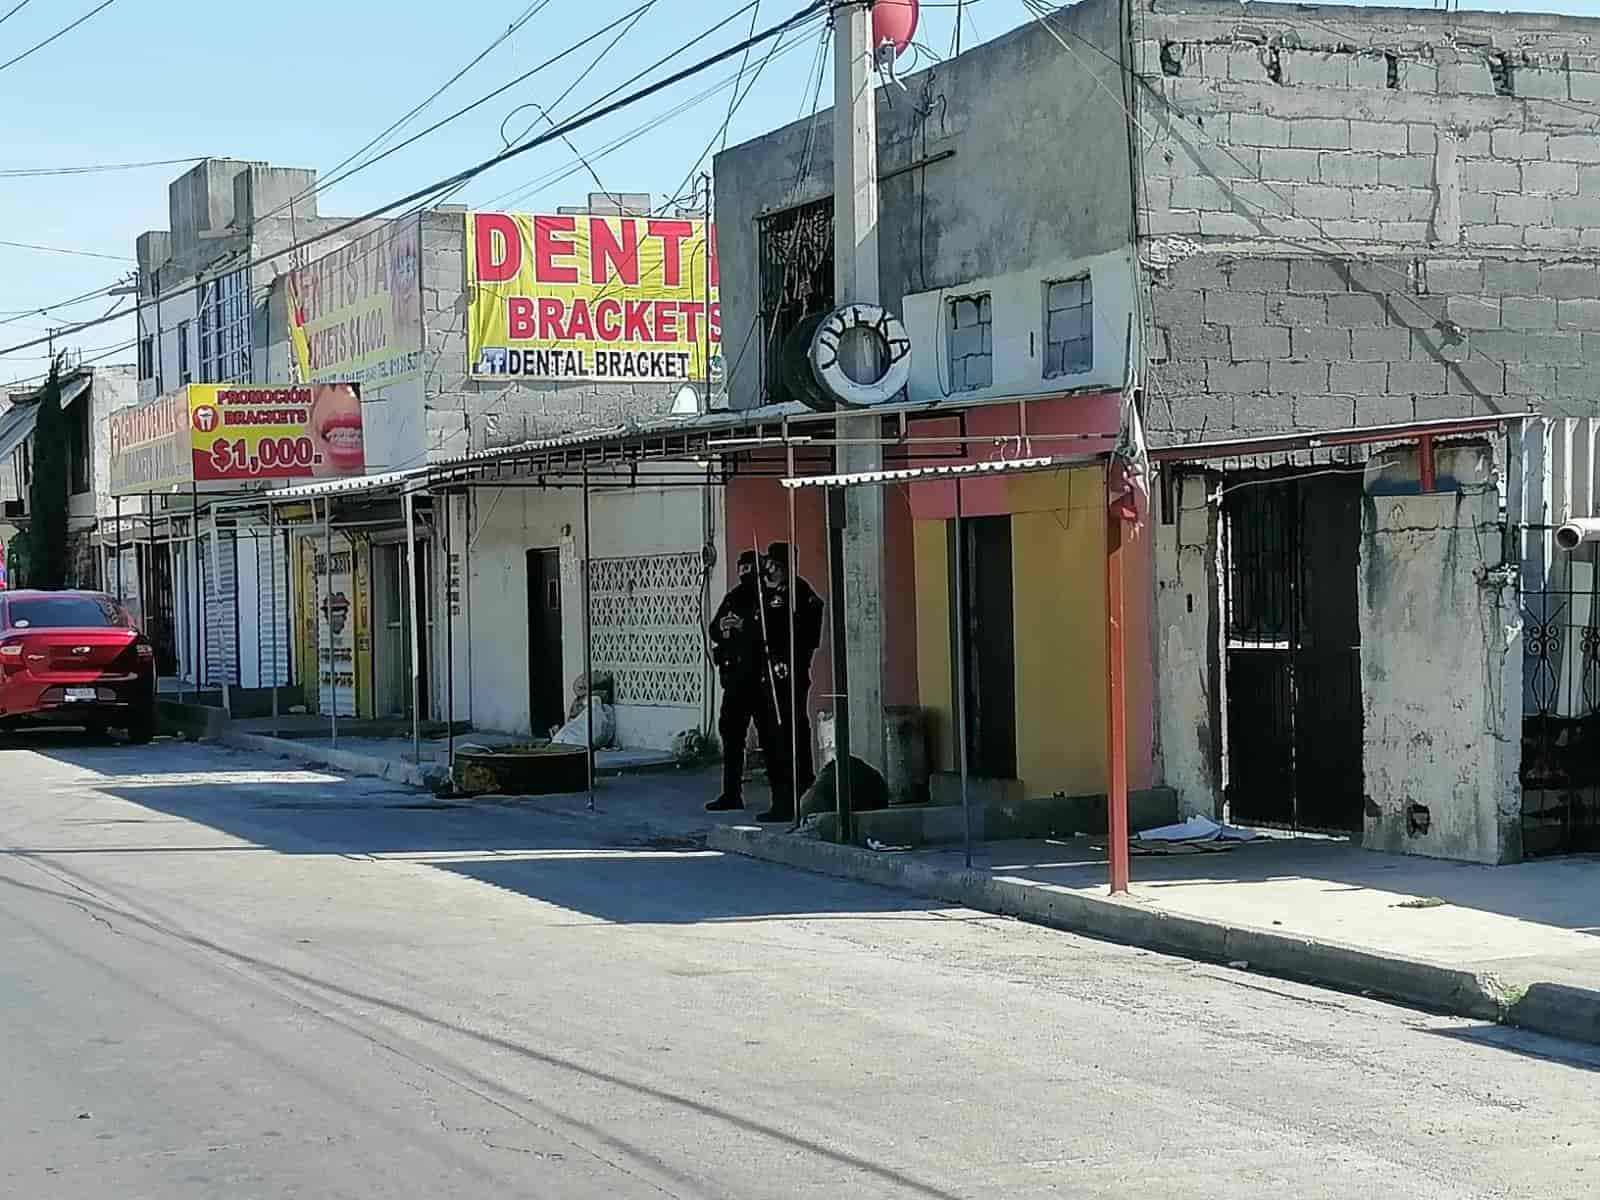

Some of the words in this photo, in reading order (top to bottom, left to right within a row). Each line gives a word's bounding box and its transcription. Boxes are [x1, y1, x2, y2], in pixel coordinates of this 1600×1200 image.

[509, 350, 588, 375] DENTAL
[596, 351, 689, 378] BRACKET
[216, 386, 312, 405] PROMOCIÓN
[223, 409, 306, 425] BRACKETS
[211, 438, 322, 471] $1,000.
